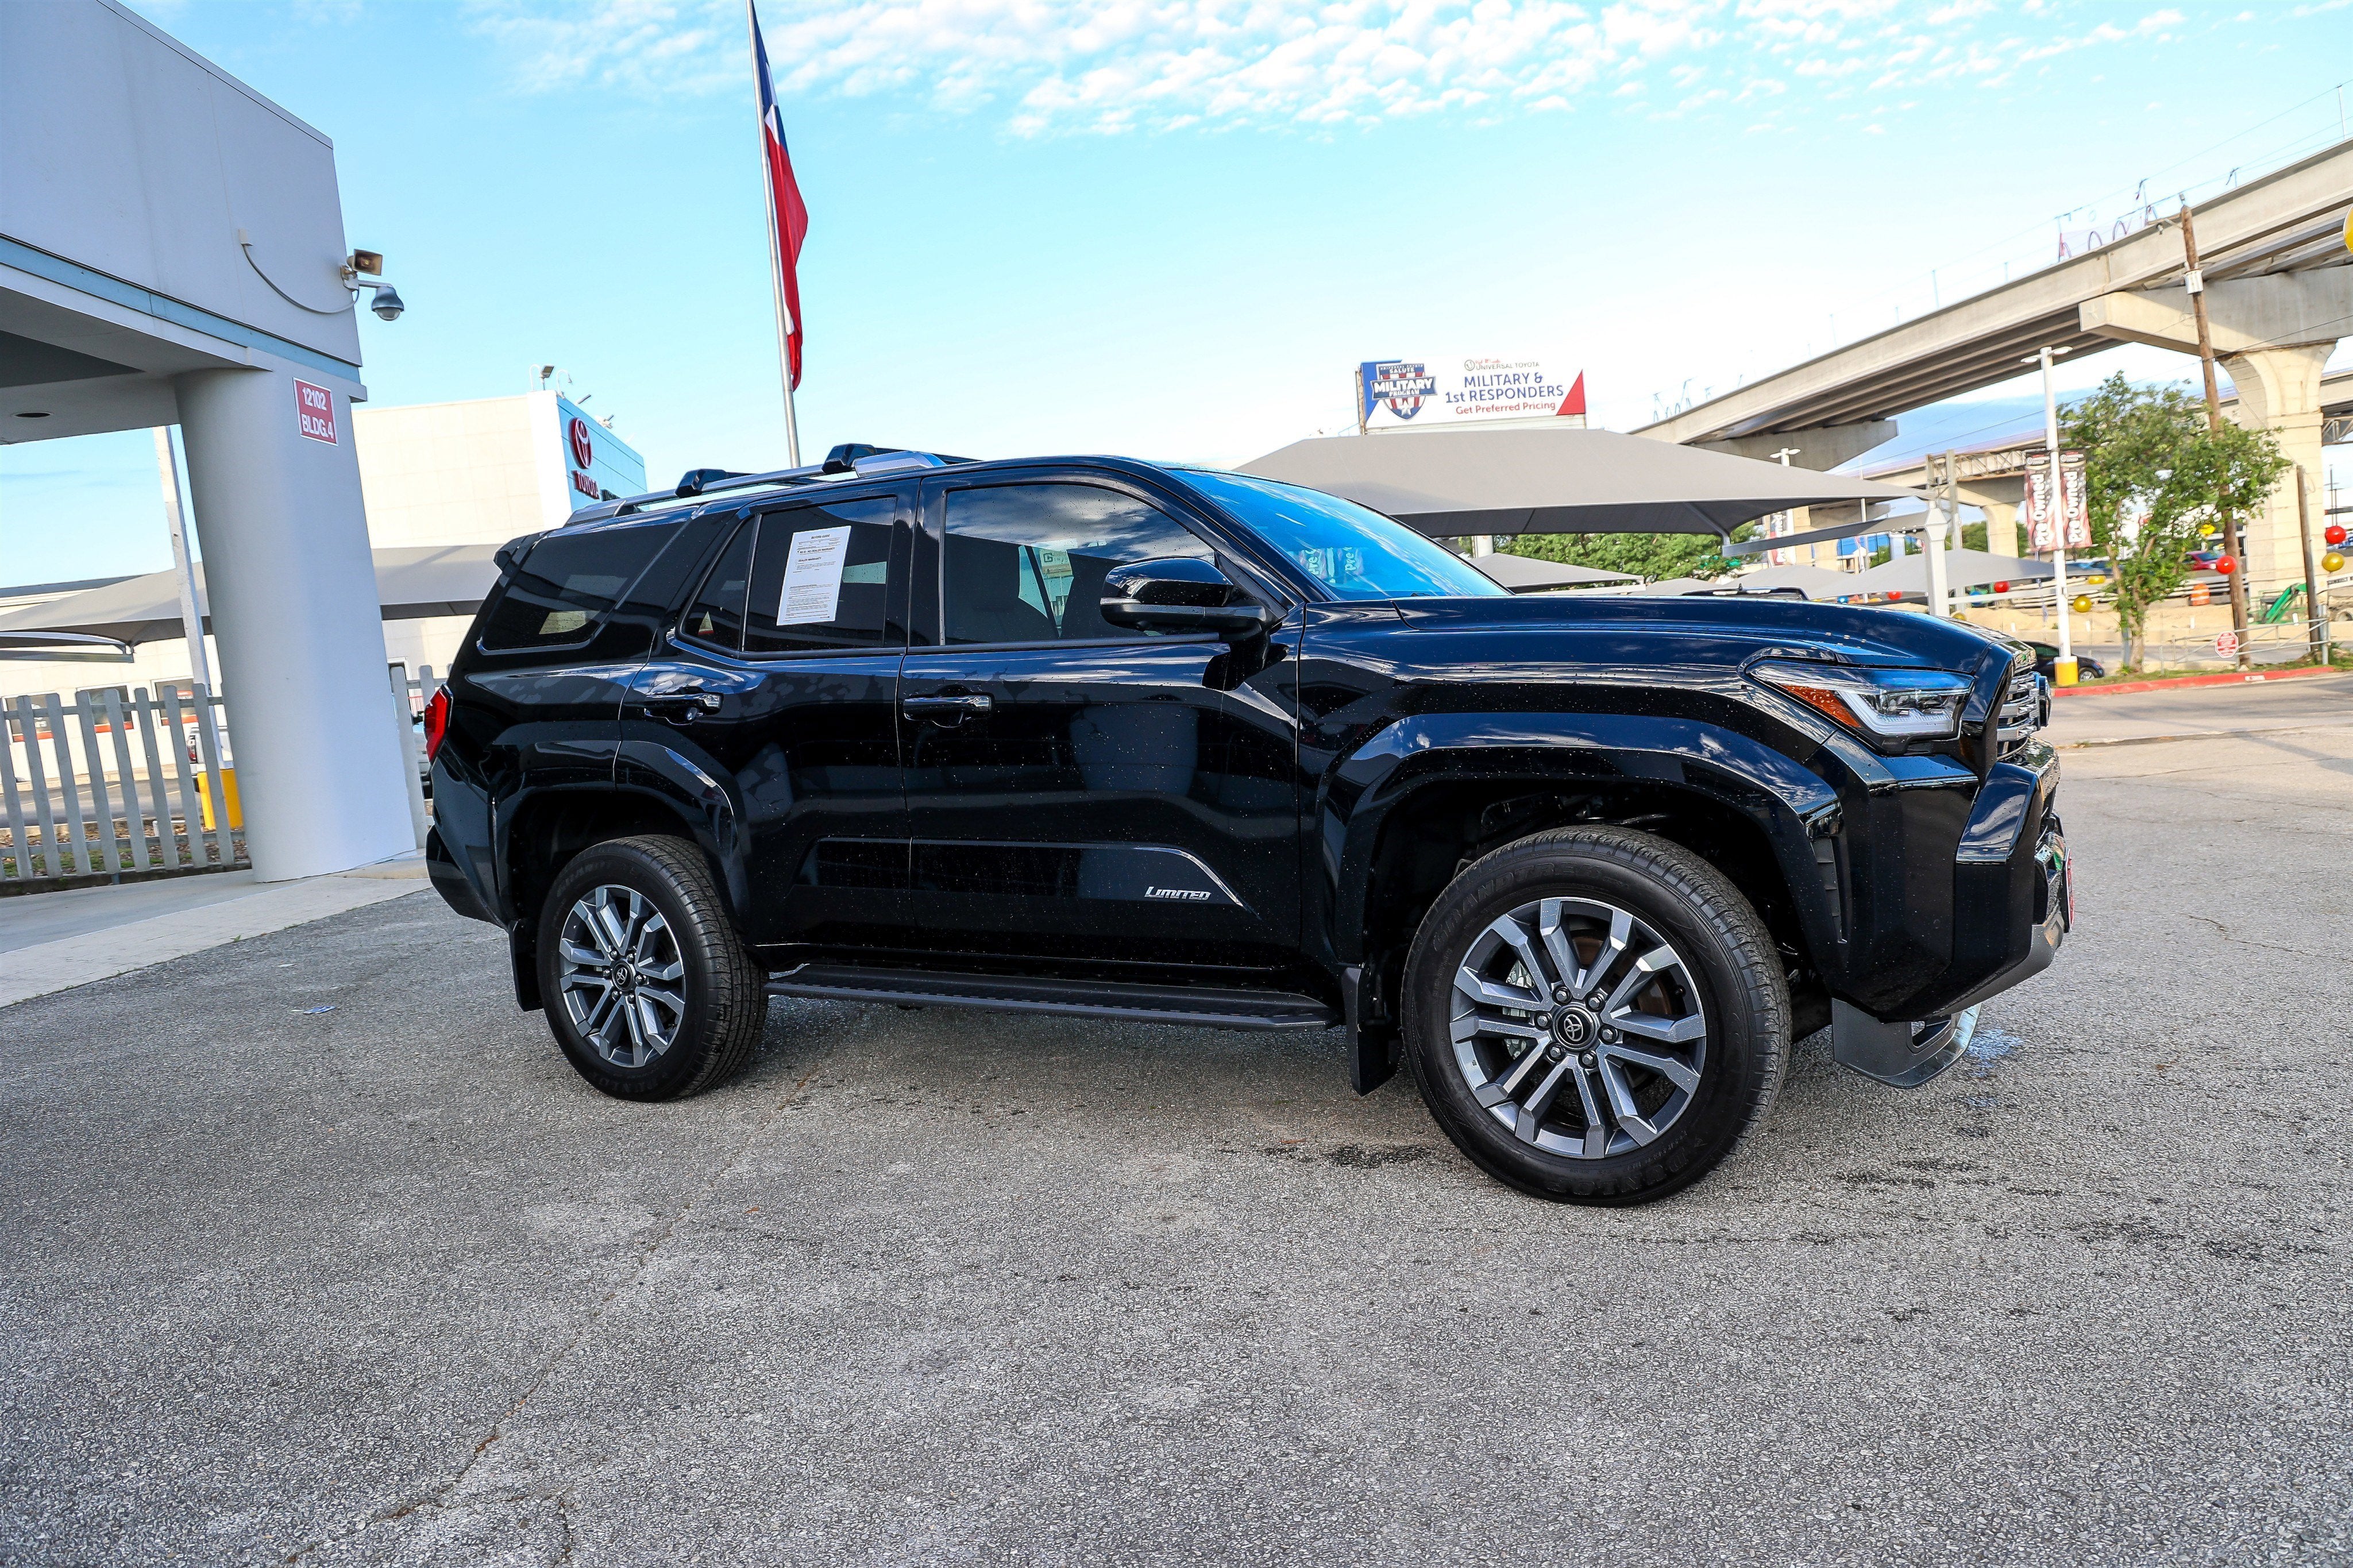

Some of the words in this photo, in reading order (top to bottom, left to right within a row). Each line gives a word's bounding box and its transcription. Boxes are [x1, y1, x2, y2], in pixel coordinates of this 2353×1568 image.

[1374, 379, 1433, 393] MILITARY
[1465, 373, 1529, 387] MILITARY
[1534, 372, 1543, 383] &
[302, 387, 327, 411] 12102
[1445, 391, 1465, 403] 1st
[1469, 385, 1564, 401] RESPONDERS
[1456, 406, 1473, 414] Get
[1475, 403, 1520, 413] Preferred
[1523, 401, 1556, 411] Pricing
[2030, 474, 2046, 522] Owned
[2063, 471, 2079, 519] Owned
[2035, 523, 2049, 546] Pre
[2068, 520, 2082, 543] Pre
